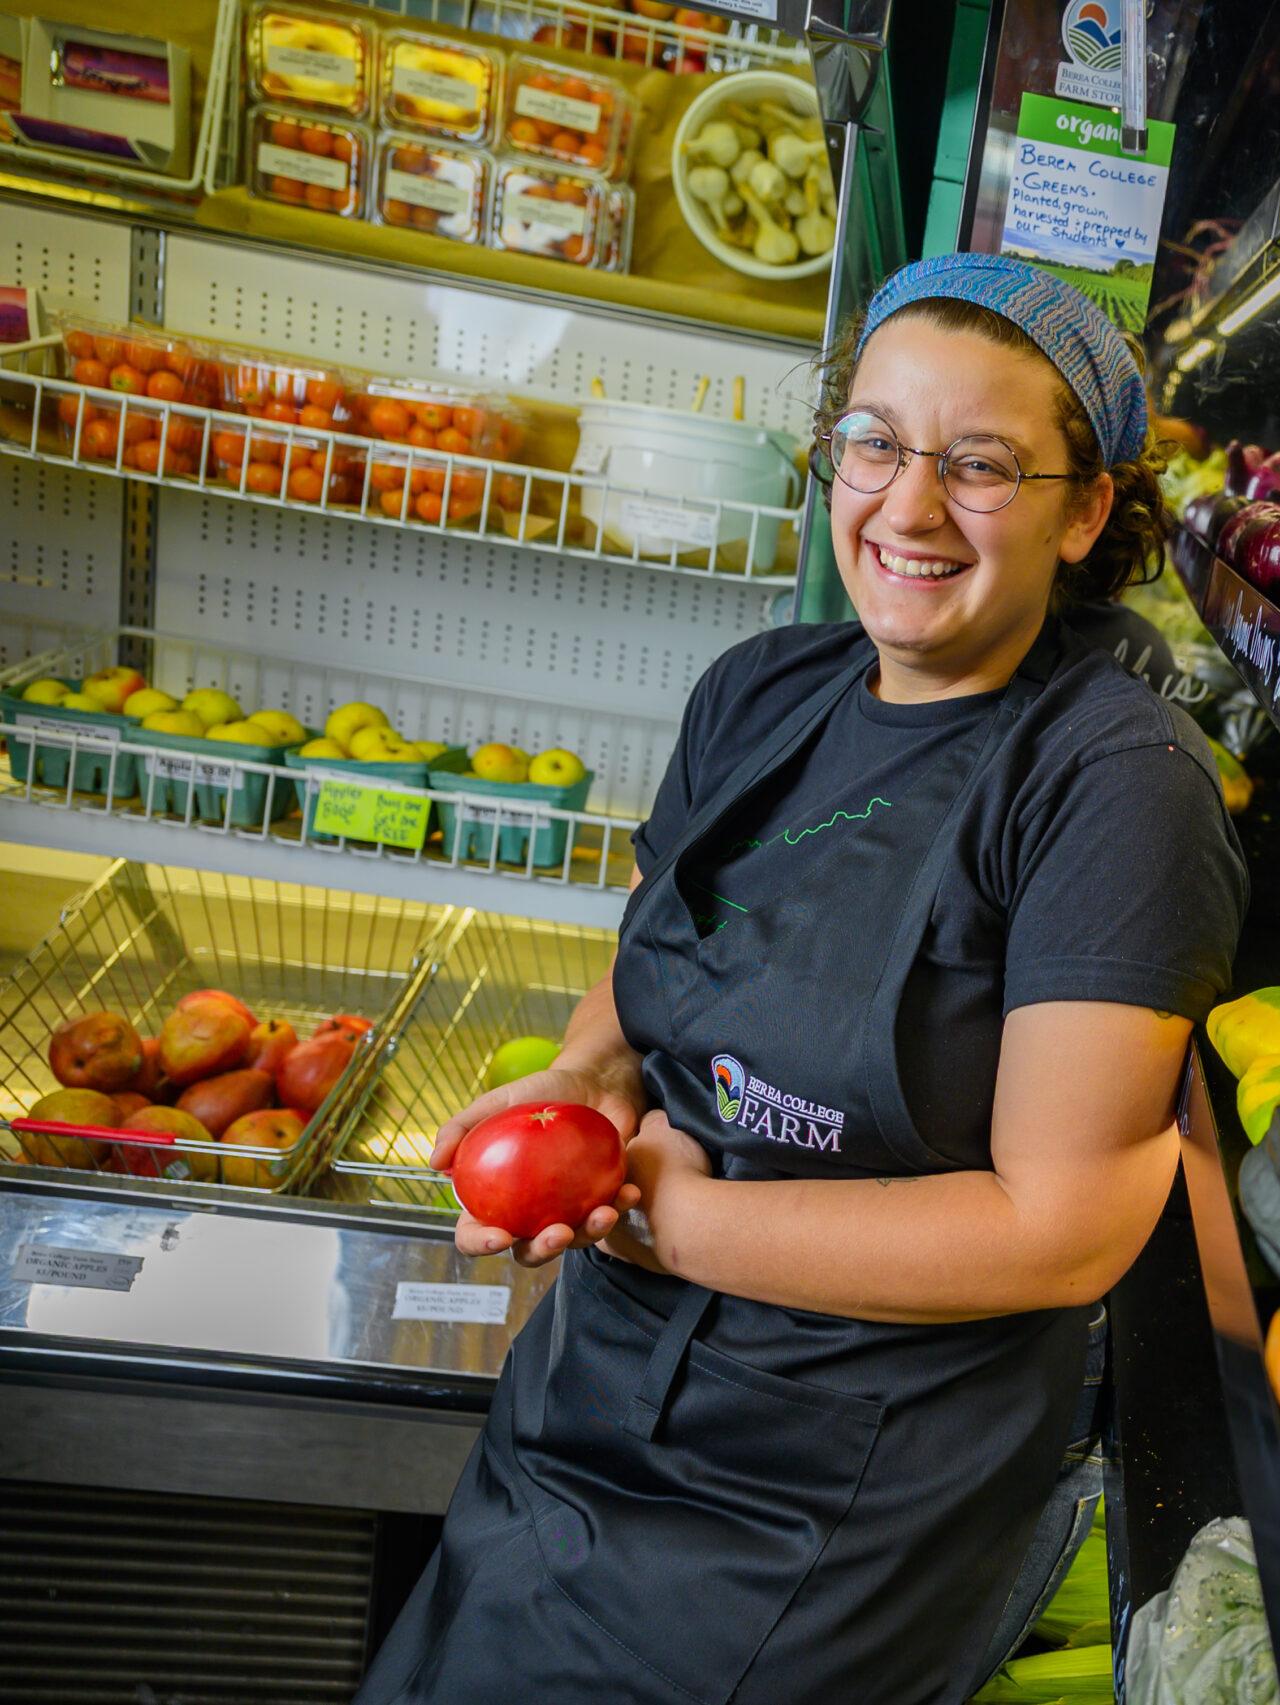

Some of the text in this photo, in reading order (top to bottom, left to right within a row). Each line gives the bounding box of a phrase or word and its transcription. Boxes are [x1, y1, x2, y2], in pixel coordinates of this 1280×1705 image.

[1058, 82, 1121, 104] FARM STOR
[1020, 144, 1157, 188] BEREA COLLEGE
[1013, 204, 1148, 246] harvested prepped by
[747, 1076, 845, 1125] BEREA COLLEGE
[737, 1096, 843, 1153] FARM
[25, 1257, 71, 1269] ORGANIC
[73, 1262, 108, 1273] APPLES
